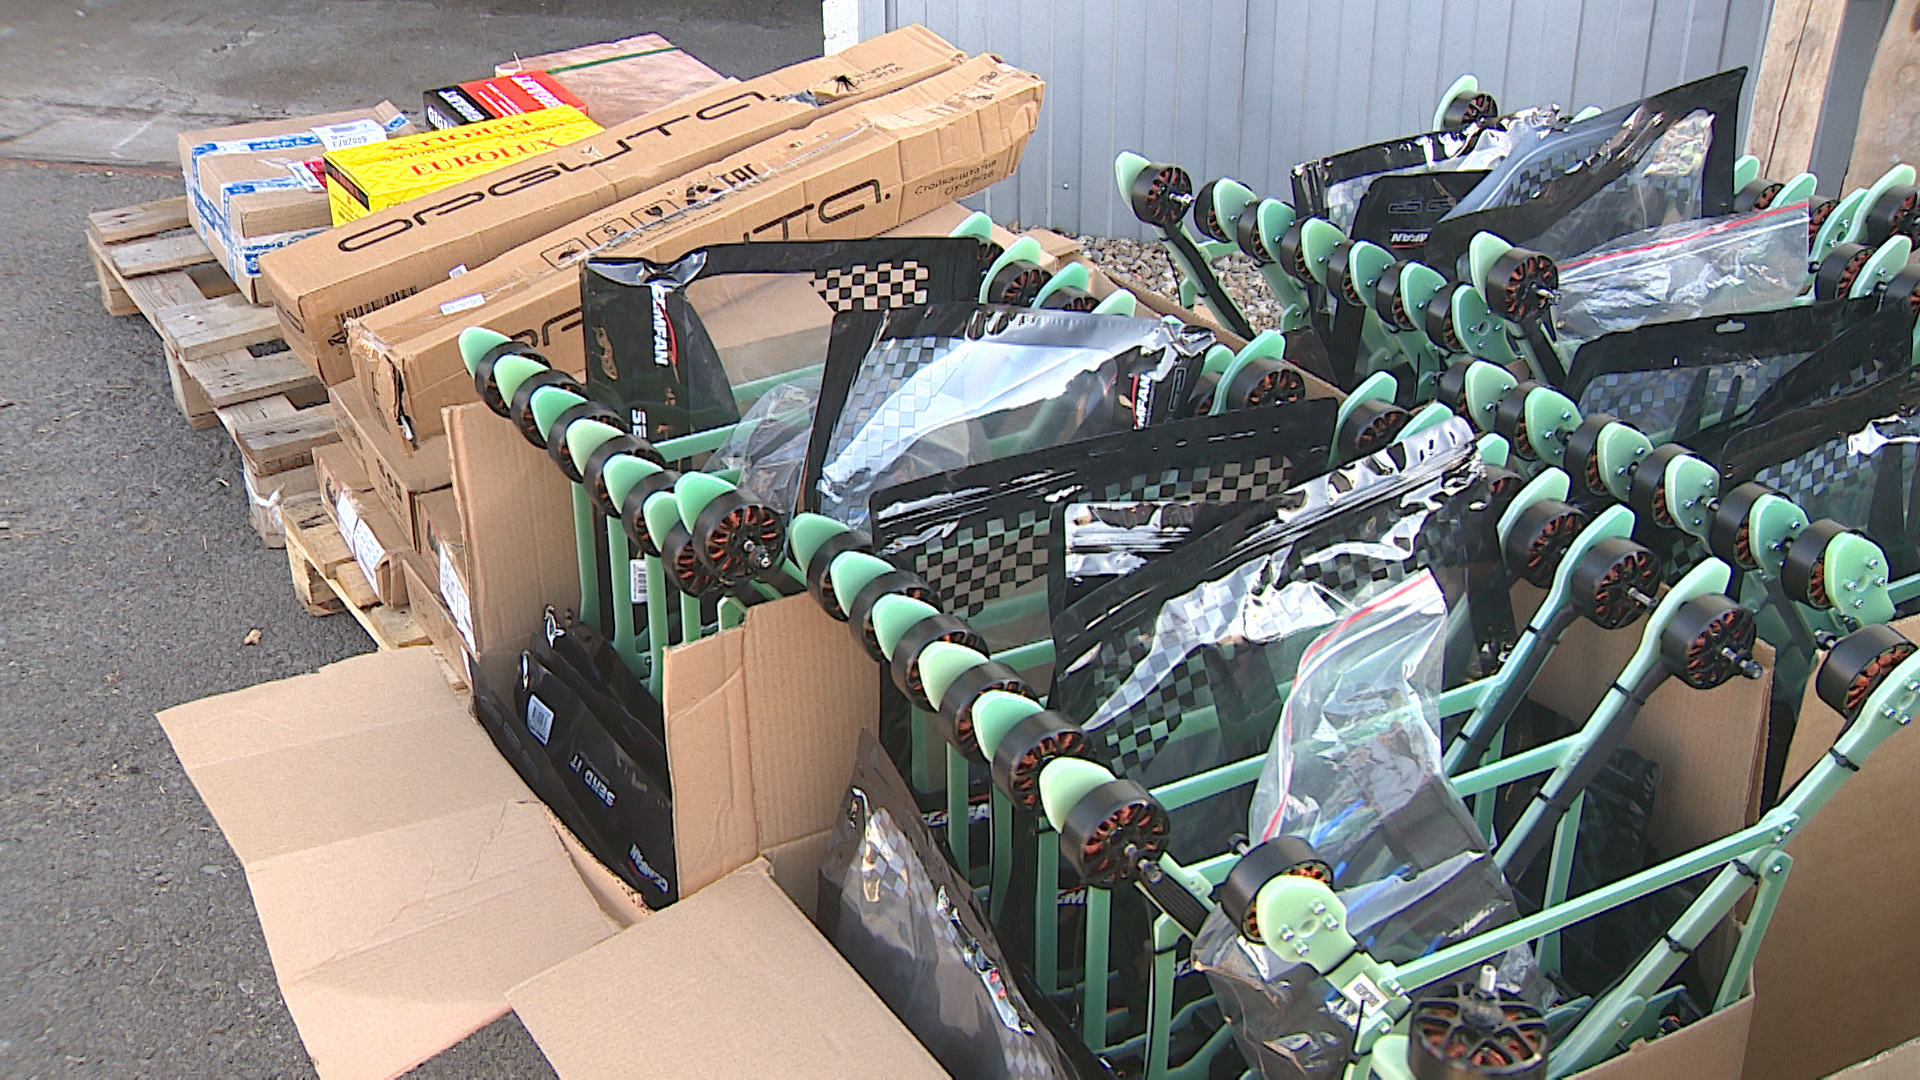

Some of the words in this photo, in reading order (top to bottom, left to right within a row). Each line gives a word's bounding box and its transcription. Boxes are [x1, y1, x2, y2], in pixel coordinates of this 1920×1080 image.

[411, 137, 560, 176] EUROLUX
[651, 283, 671, 367] GEMFAN
[568, 752, 583, 775] IT
